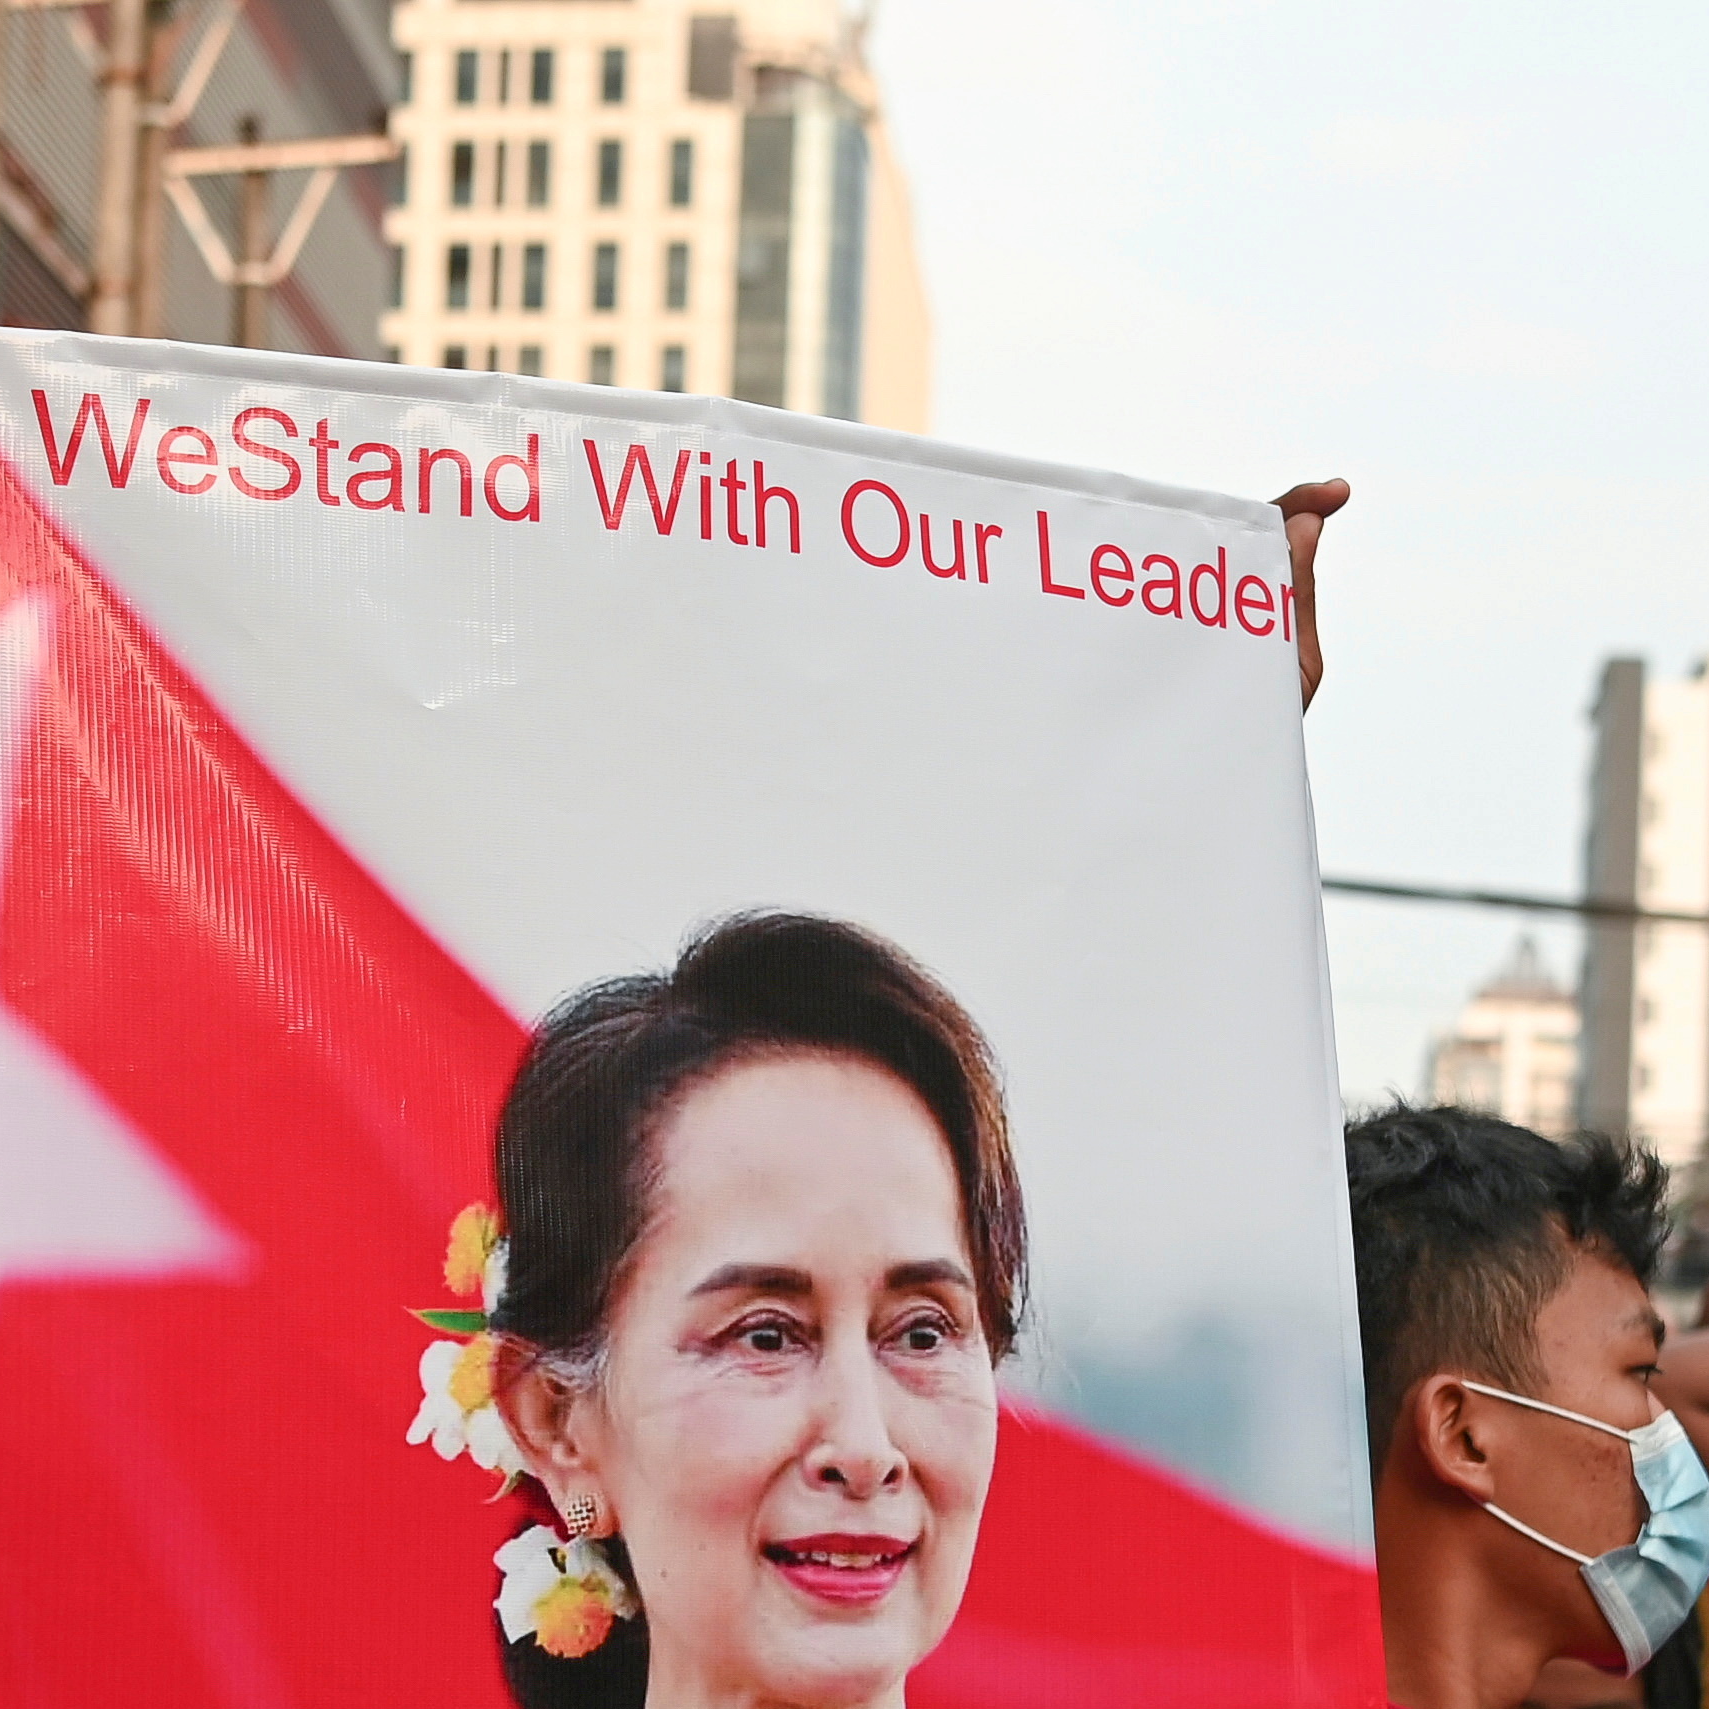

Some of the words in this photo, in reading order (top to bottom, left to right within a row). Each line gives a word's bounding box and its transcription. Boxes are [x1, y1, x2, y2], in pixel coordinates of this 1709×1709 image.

[30, 389, 541, 523] WeStand
[582, 438, 801, 554] With
[840, 479, 1004, 584] Our
[1036, 510, 1293, 642] Leader
